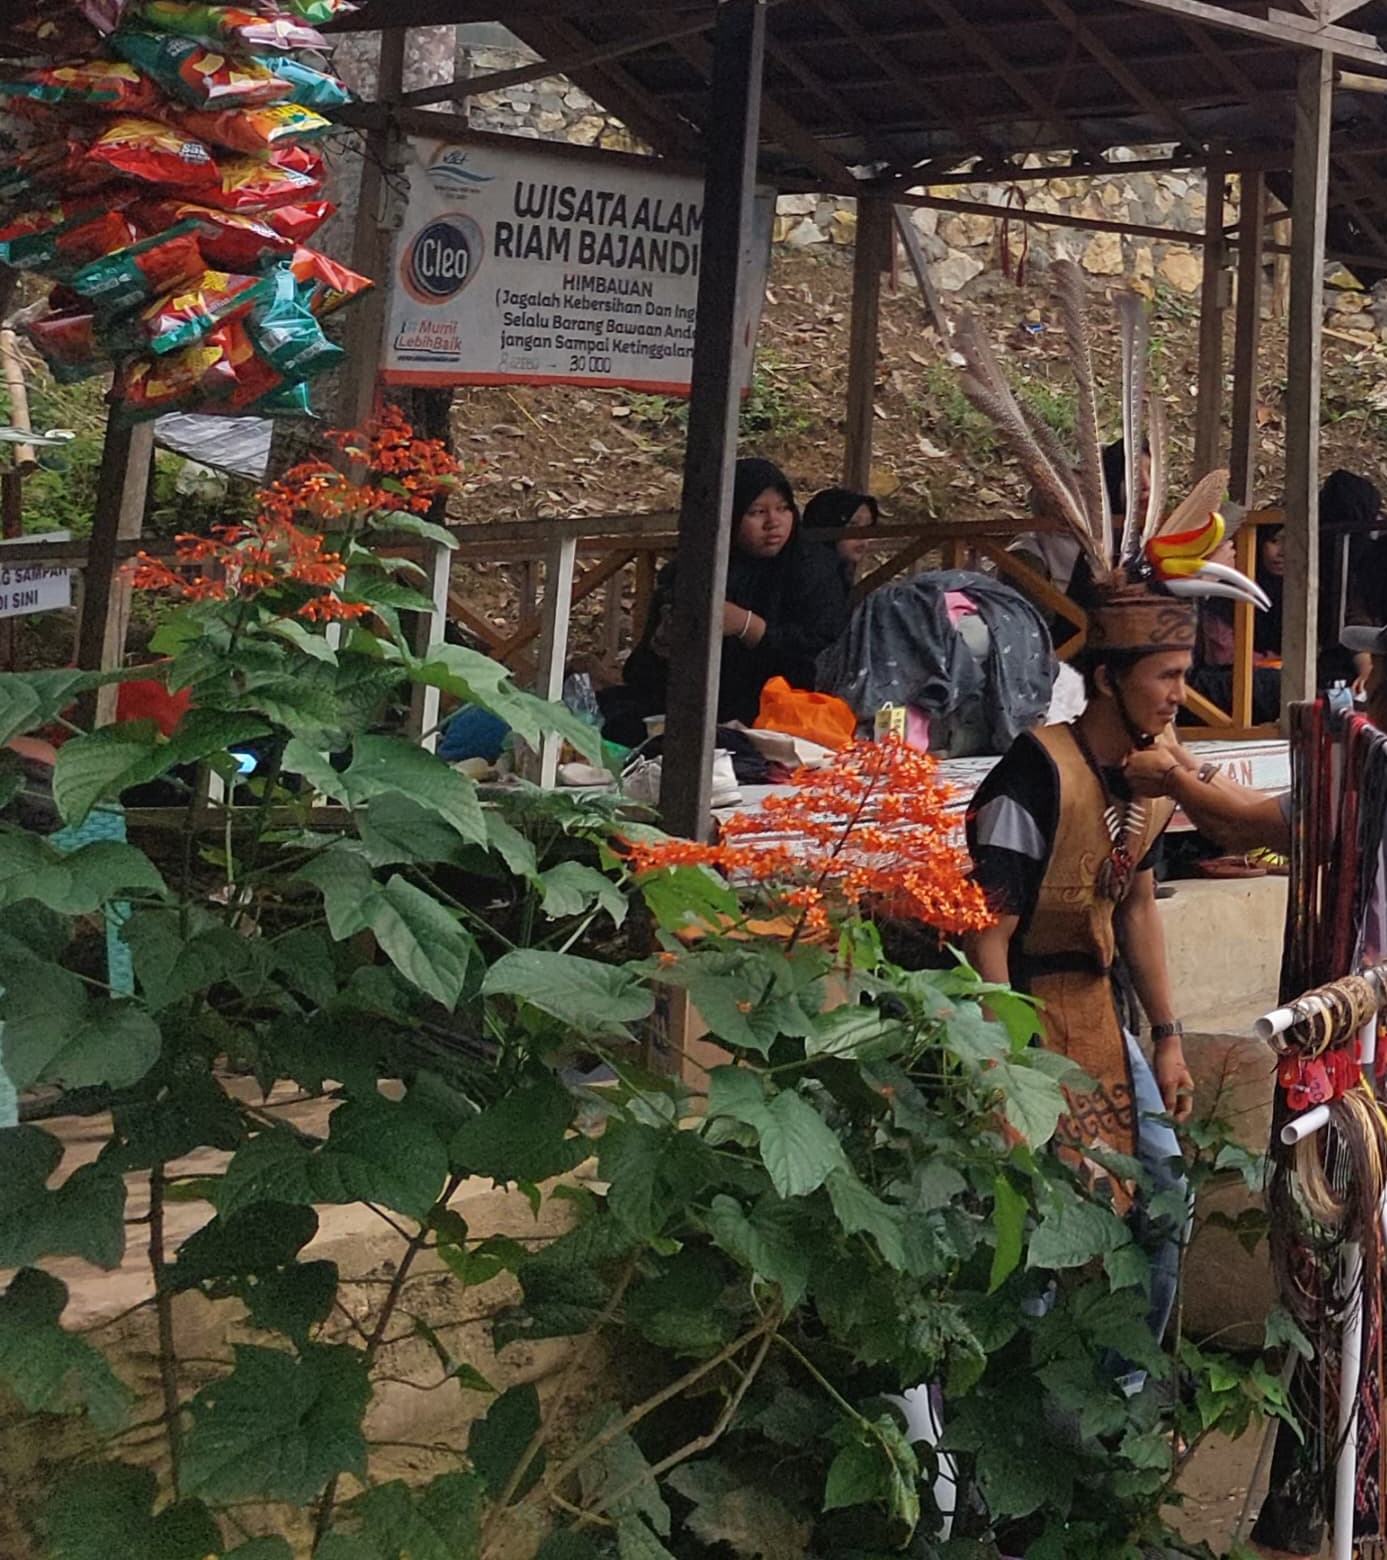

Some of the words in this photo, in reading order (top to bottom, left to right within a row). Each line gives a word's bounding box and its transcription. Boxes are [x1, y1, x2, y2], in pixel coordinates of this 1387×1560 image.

[514, 181, 627, 228] WISATA
[422, 238, 468, 279] Cleo
[494, 221, 571, 262] RIAM
[578, 229, 699, 276] BAJANDI
[562, 273, 653, 298] HIMBAUAN
[563, 294, 642, 315] Kebersihan
[645, 302, 671, 318] Dan
[675, 304, 696, 322] Ing
[503, 311, 549, 329] Selalu
[553, 315, 603, 335] Barang
[606, 319, 661, 337] Bawaan
[501, 330, 551, 351] jangan
[555, 335, 609, 355] Sampai
[12, 589, 38, 608] SINI
